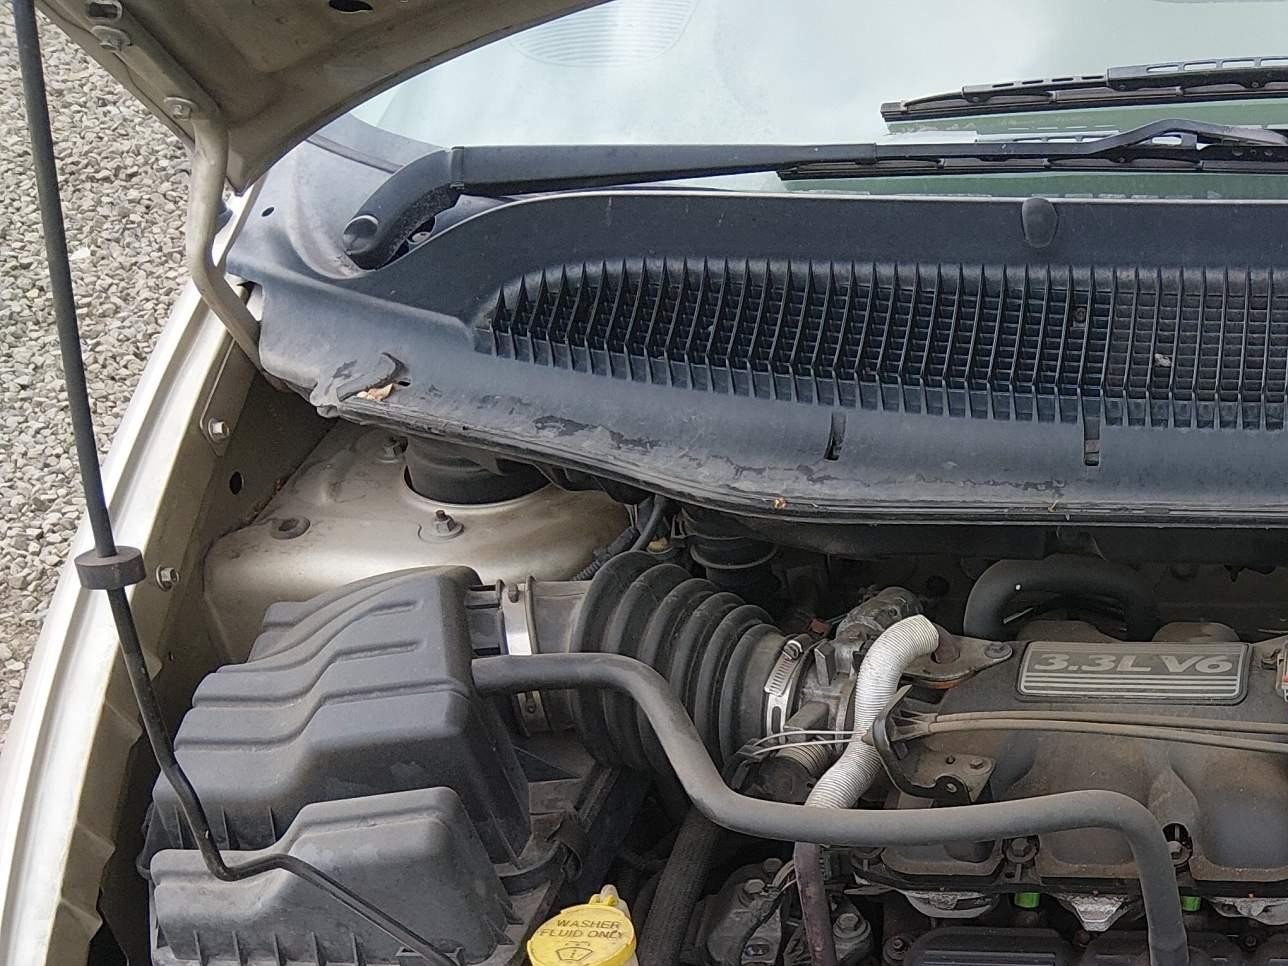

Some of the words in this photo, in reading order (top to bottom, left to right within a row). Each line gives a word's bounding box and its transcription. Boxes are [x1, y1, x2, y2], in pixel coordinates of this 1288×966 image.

[1034, 654, 1150, 672] 3.3L
[1163, 656, 1233, 673] V6
[557, 920, 620, 929] WASHER
[540, 928, 584, 937] FLUID
[587, 930, 624, 940] ONLY
